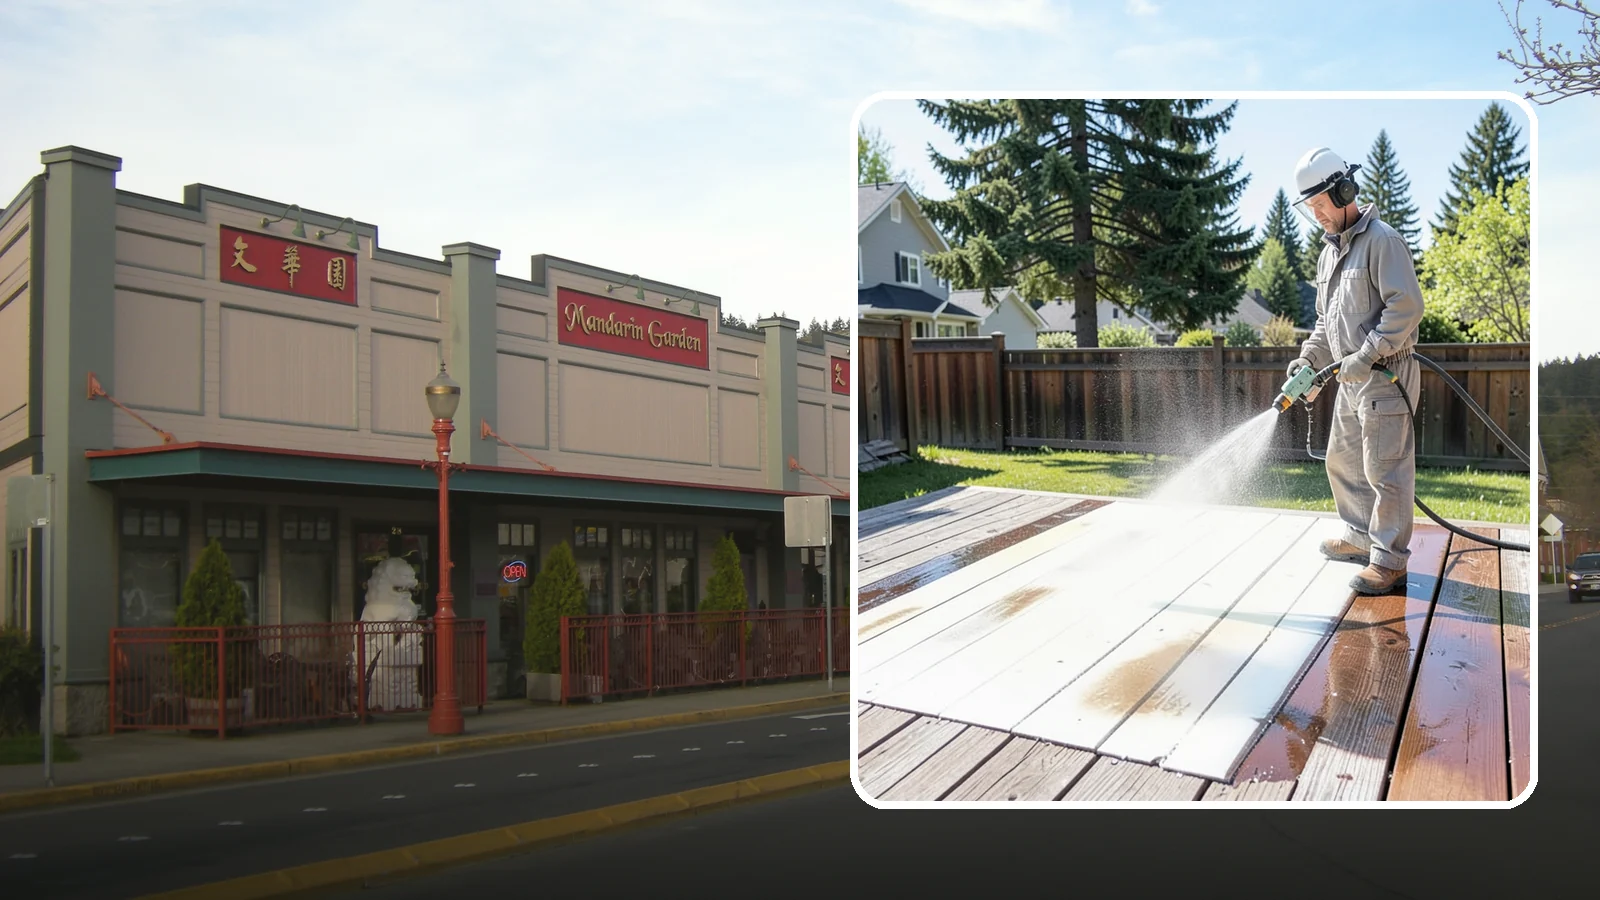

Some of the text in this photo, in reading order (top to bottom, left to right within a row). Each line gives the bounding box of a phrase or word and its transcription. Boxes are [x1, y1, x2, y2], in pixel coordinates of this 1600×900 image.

[230, 235, 346, 291] 文華園
[564, 302, 702, 352] Mandarin Garden
[835, 363, 846, 386] 文
[391, 526, 402, 535] 28
[503, 565, 527, 578] OPEN
